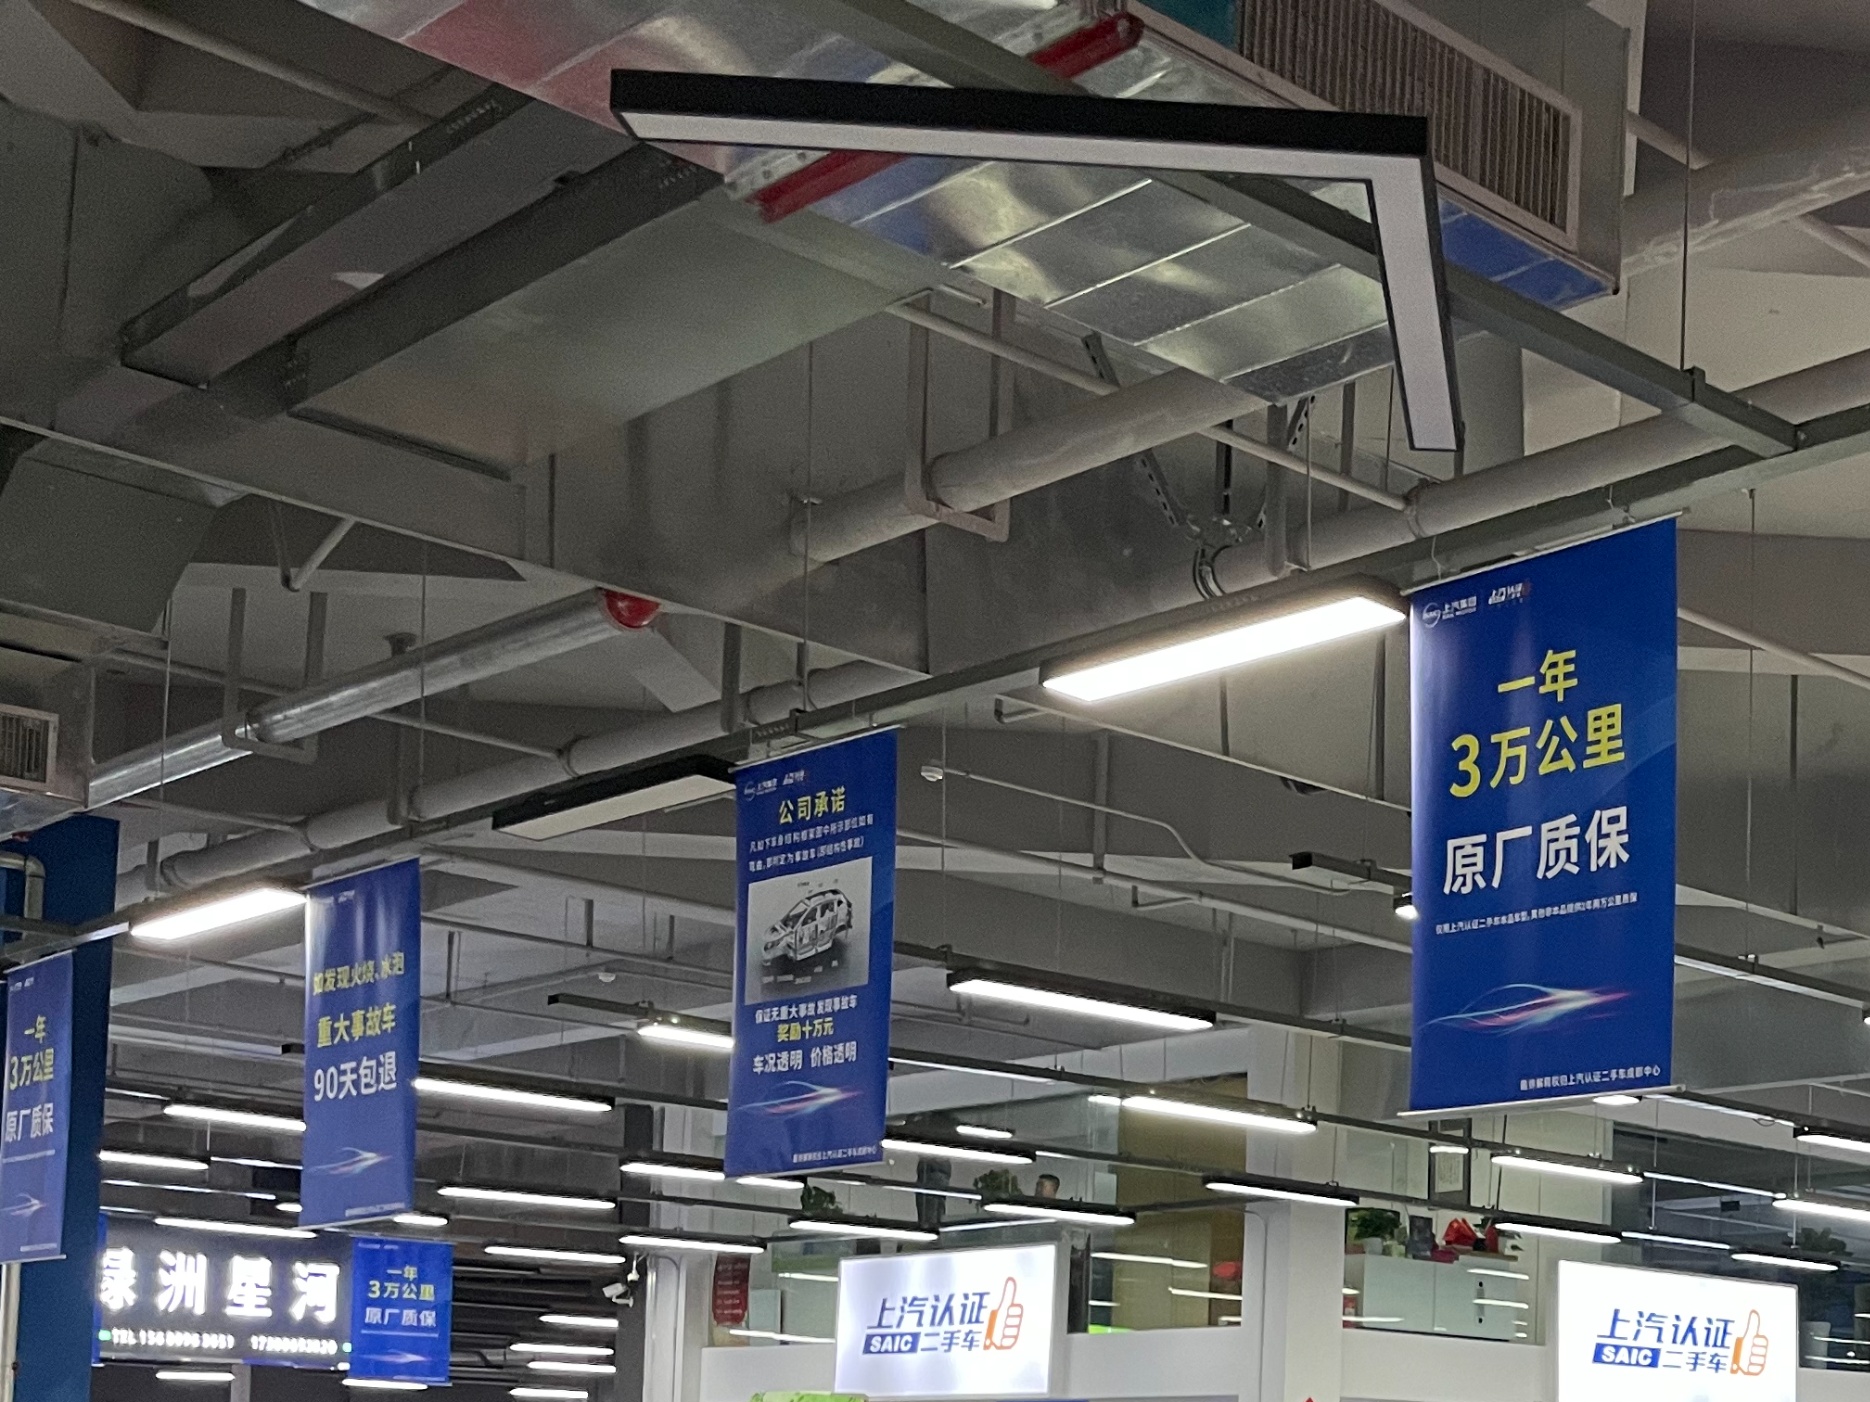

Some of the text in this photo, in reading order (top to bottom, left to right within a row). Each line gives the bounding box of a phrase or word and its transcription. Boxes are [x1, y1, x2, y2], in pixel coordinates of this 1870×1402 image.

[1497, 648, 1578, 702] 一年
[1450, 702, 1626, 798] 3万公里
[779, 785, 845, 825] 公司承诺
[1443, 806, 1630, 895] 原厂质保
[24, 1015, 46, 1043] 一年
[317, 1002, 397, 1048] 重大事故车
[10, 1048, 54, 1090] 3万公里
[314, 1051, 397, 1102] 90天包退
[753, 1041, 857, 1075] 车况透明 价格透明
[5, 1102, 54, 1143] 原厂质保
[367, 1280, 436, 1301] 3万公里
[387, 1265, 418, 1280] 一年
[365, 1307, 437, 1328] 原厂质保
[867, 1292, 990, 1329] 上汽认证
[1597, 1309, 1735, 1349] 上汽认证
[869, 1330, 982, 1353] SAIC 二手车
[1601, 1346, 1728, 1373] SAIC 二手车
